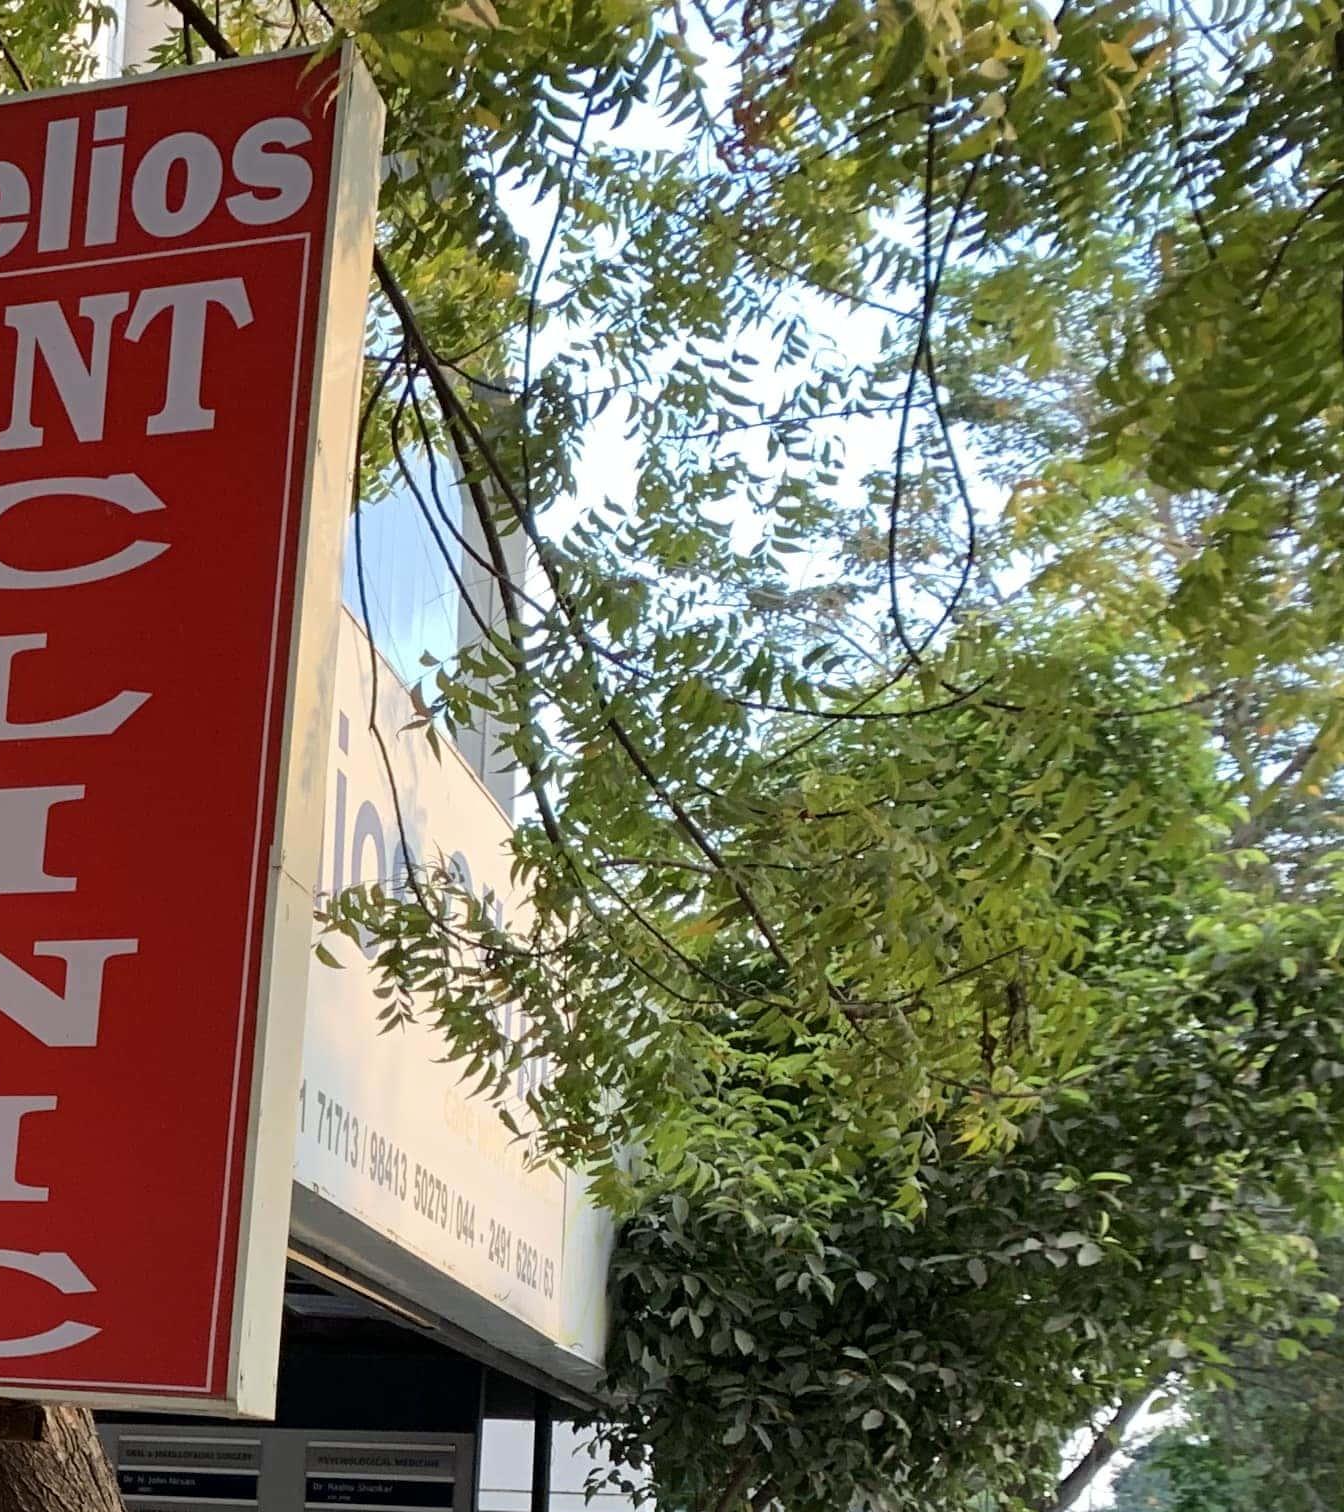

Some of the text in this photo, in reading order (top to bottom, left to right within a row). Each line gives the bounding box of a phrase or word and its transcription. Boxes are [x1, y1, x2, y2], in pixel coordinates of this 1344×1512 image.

[317, 1090, 360, 1169] 71713
[369, 1131, 408, 1202] 98413
[413, 1163, 448, 1231] 50279
[456, 1194, 477, 1249] 044
[488, 1218, 512, 1273] 2491
